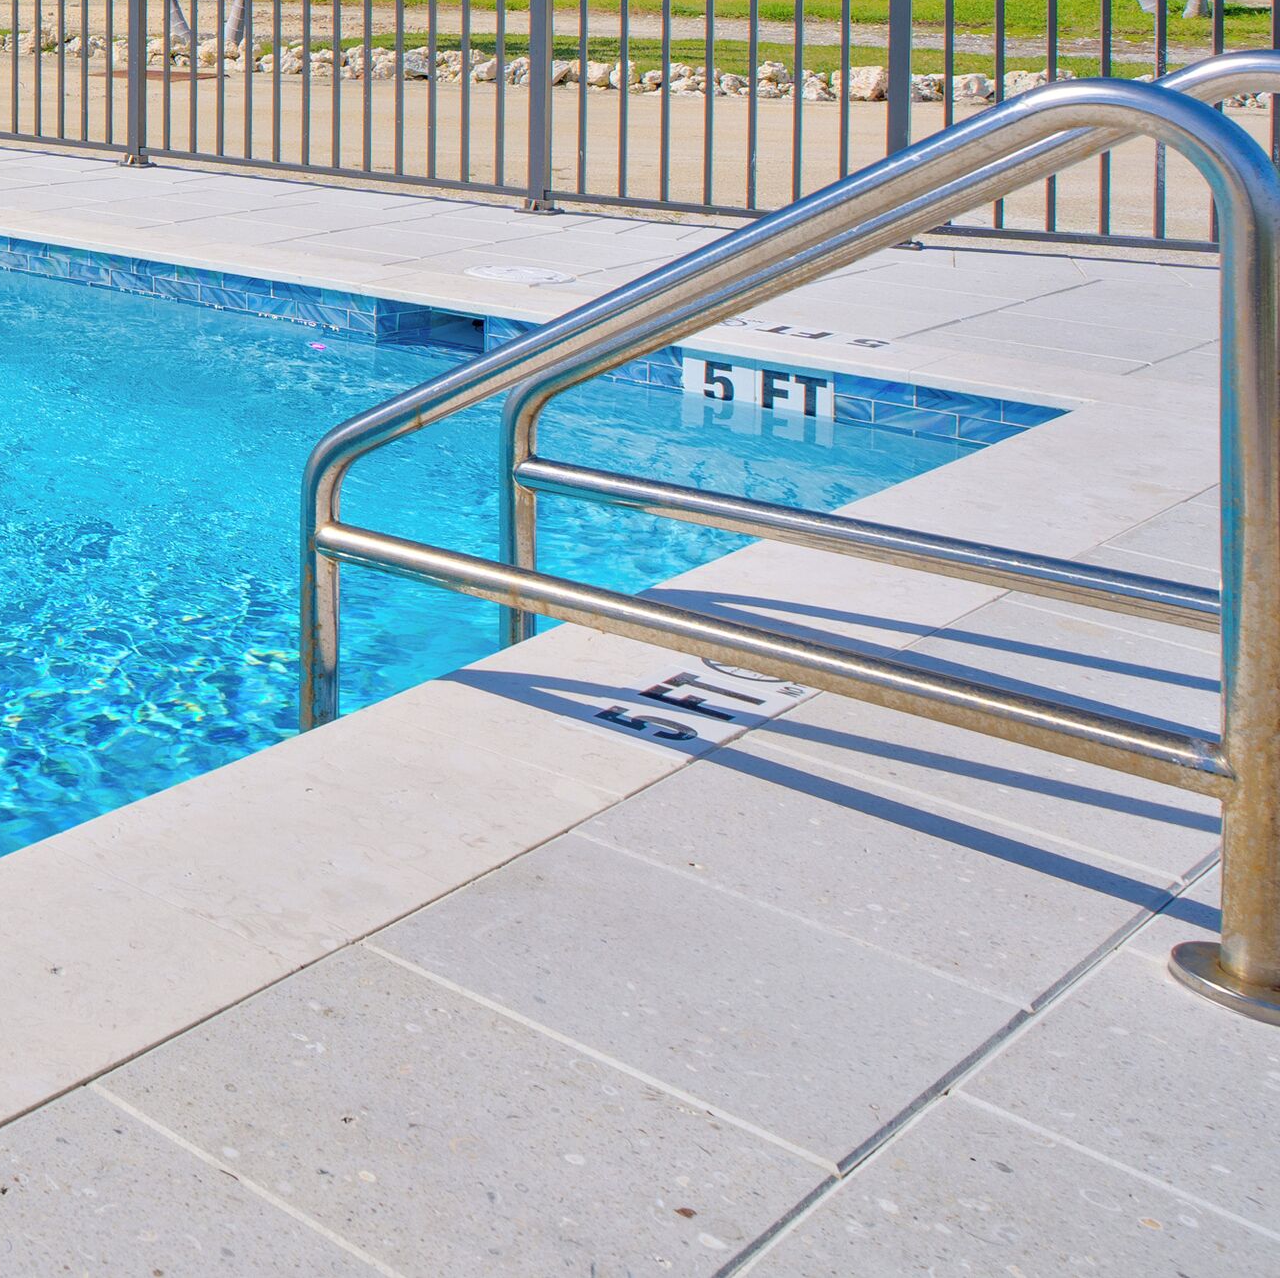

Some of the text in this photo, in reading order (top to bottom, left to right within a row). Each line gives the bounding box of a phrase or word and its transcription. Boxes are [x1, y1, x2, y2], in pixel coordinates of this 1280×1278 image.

[755, 325, 891, 349] 5 FT
[703, 359, 828, 417] 5 FT
[593, 671, 767, 741] 5 FT
